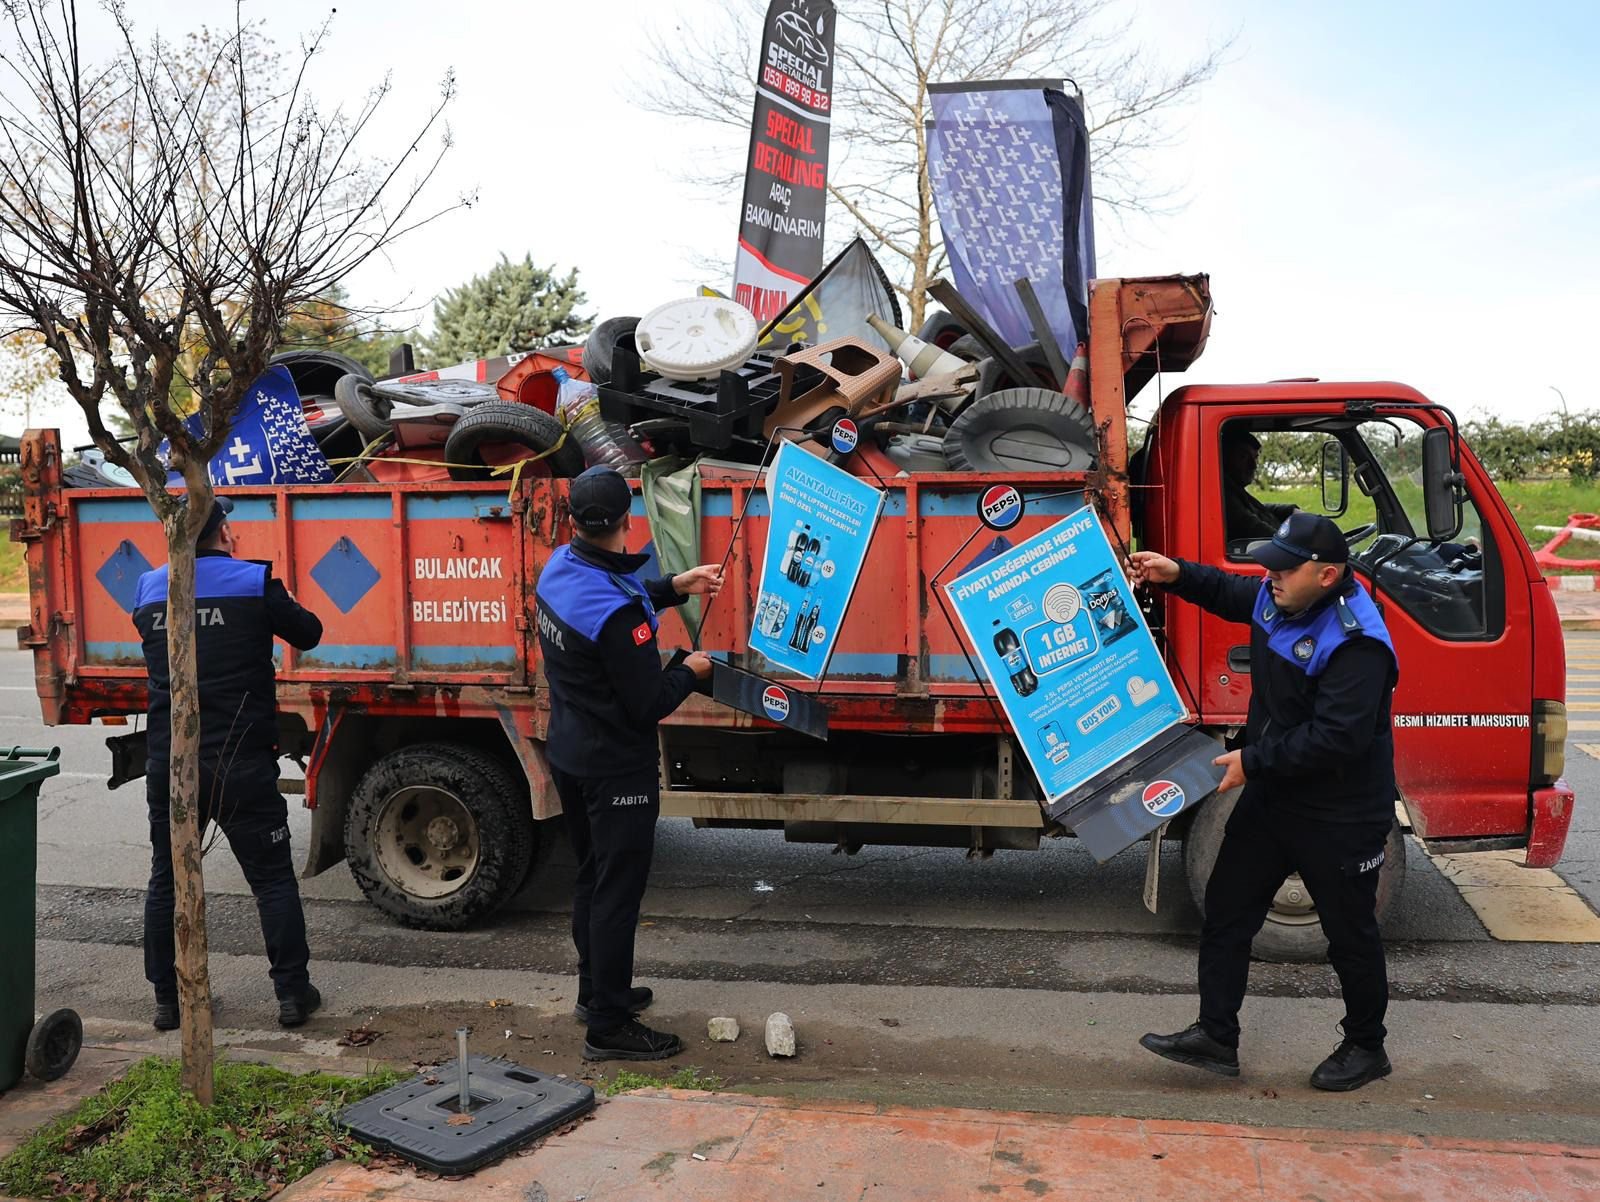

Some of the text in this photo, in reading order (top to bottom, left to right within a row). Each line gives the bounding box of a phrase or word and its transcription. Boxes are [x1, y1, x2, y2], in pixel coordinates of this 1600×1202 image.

[767, 41, 827, 93] SPECIAL
[776, 60, 816, 89] DETAILING
[763, 66, 829, 110] 0531 899 98 32
[766, 109, 816, 154] SPECIAL
[754, 141, 825, 189] DETAILING
[769, 182, 791, 213] ARAÇ
[745, 203, 822, 240] BAKIM ONARIM
[834, 426, 856, 443] PEPSI
[785, 466, 867, 516] AVANTAJLI FİYAT
[985, 493, 1018, 517] PEPSI
[415, 556, 502, 579] BULANCAK
[957, 517, 1093, 601] FİYATI DEĞERİNDE HEDİYE
[987, 543, 1077, 601] ANINDA CEBİNDE
[152, 607, 225, 630] ZTA
[413, 595, 507, 623] BELEDİYESİ
[1041, 623, 1077, 650] 1 GB
[764, 695, 788, 712] PEPSI
[1081, 699, 1116, 731] BOŞ YOK!
[1394, 712, 1530, 727] RESMİ HİZMETE MAHSUSTUR
[612, 794, 649, 806] ZABITA
[1147, 786, 1180, 810] PEPSI
